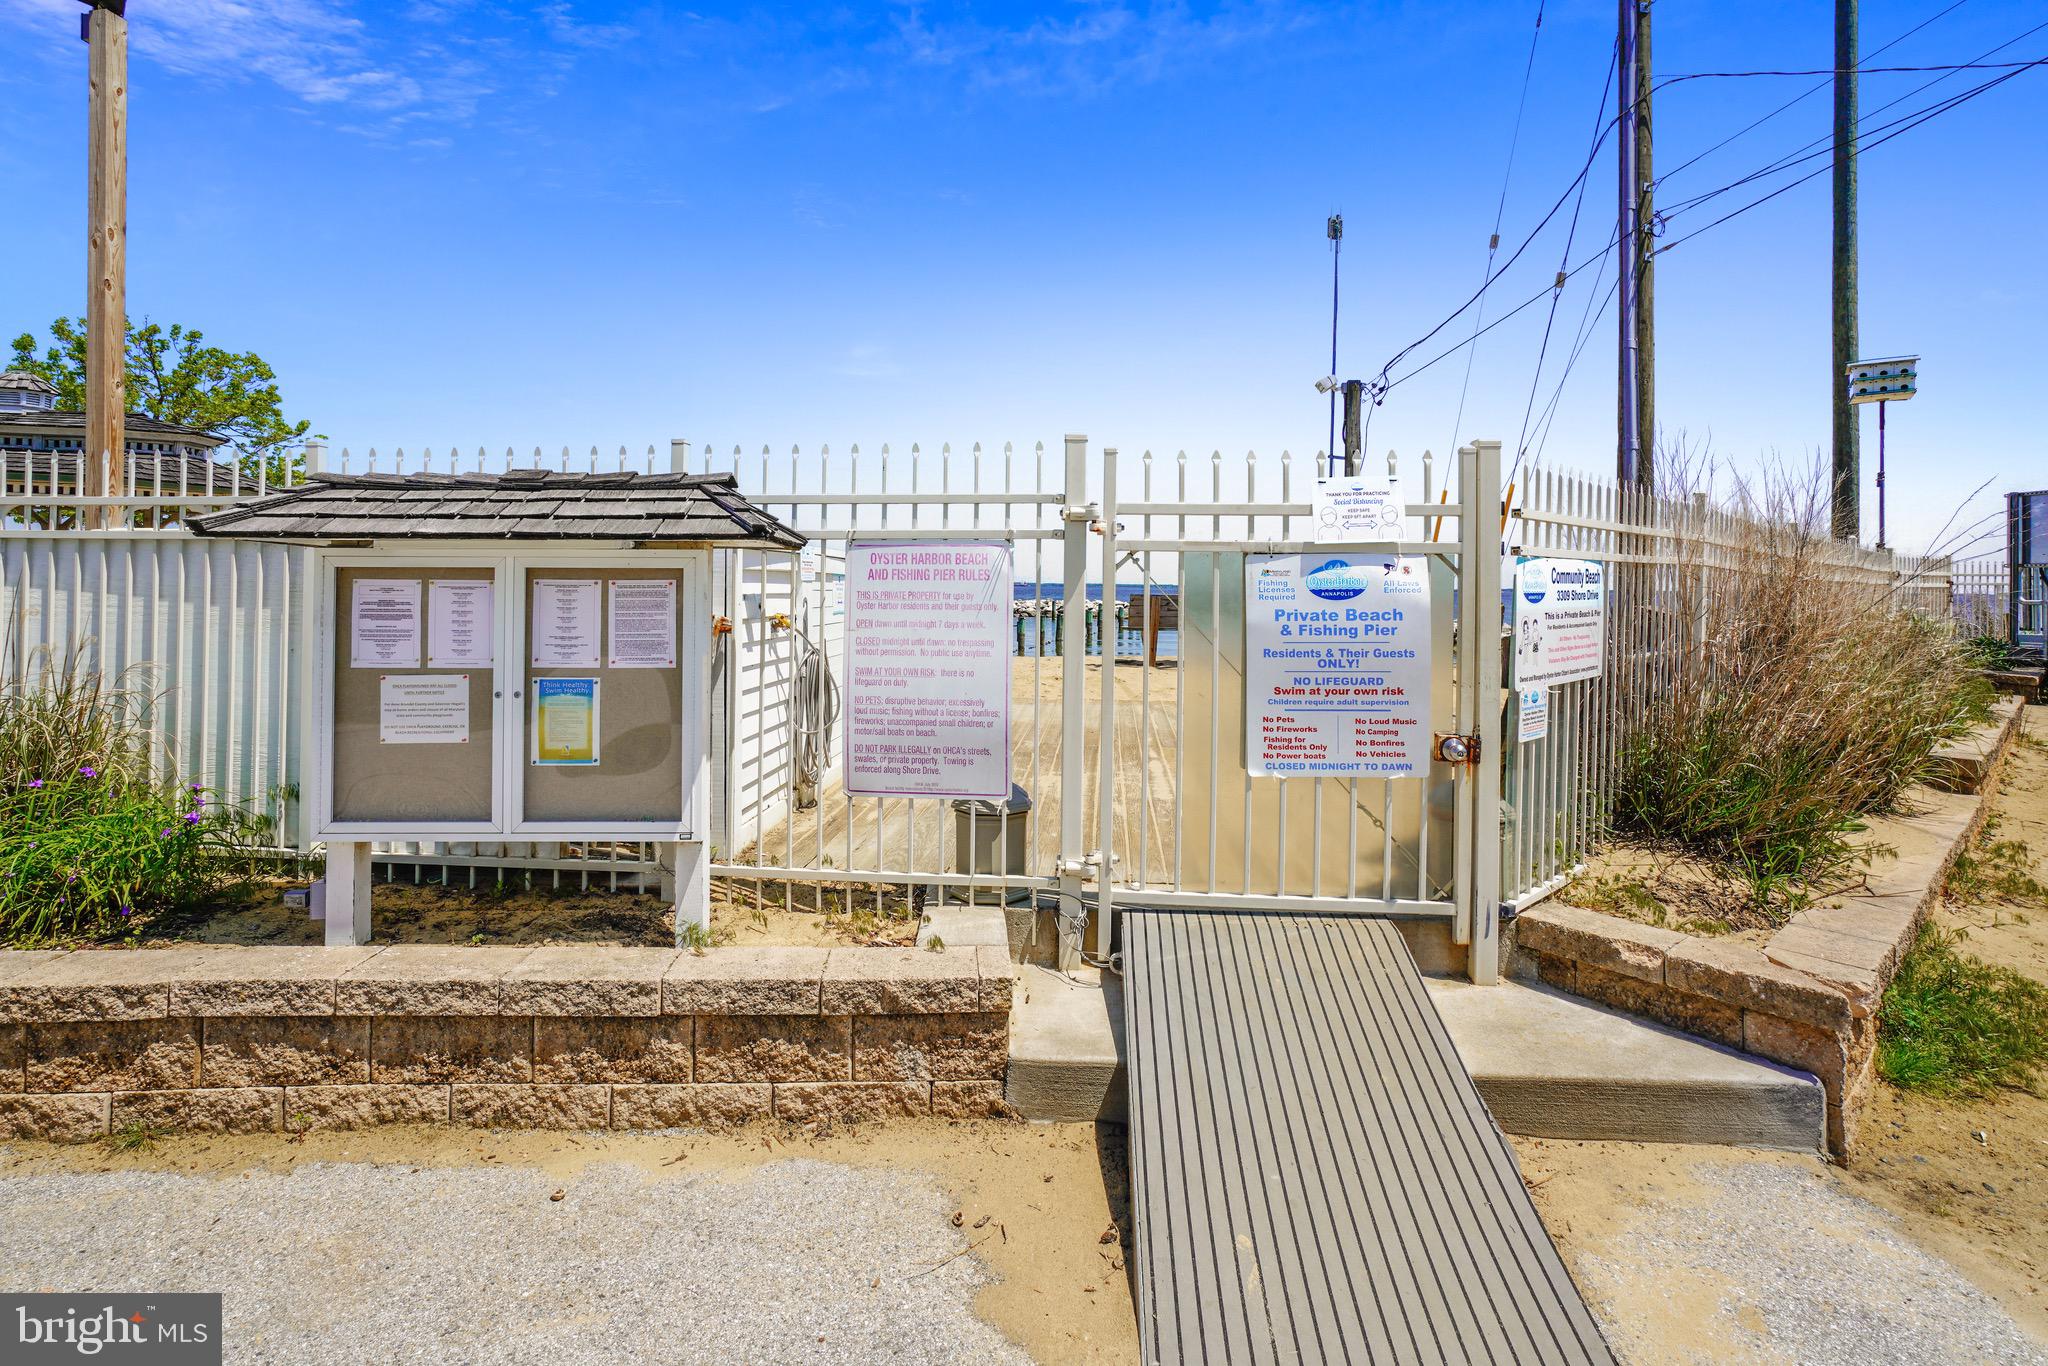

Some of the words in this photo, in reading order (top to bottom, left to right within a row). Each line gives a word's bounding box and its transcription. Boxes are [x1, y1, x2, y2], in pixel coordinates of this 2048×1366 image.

[870, 553, 908, 565] OYSTER
[911, 553, 951, 565] HARBOR
[955, 553, 988, 565] BEACH
[868, 569, 888, 581] AND
[892, 569, 930, 581] FISHING
[934, 569, 956, 580] PIER
[959, 569, 990, 581] RULES
[1552, 567, 1584, 588] Community
[1585, 568, 1600, 584] Beach
[857, 591, 870, 600] THIS
[873, 591, 878, 600] IS
[880, 591, 907, 600] PRIVATE
[908, 592, 941, 600] PROPERTY
[942, 592, 951, 600] for
[966, 592, 974, 601] by
[1557, 590, 1570, 601] 3309
[1571, 590, 1586, 600] Shore
[1587, 590, 1599, 600] Drive
[856, 602, 876, 611] Oyster
[945, 602, 959, 610] their
[961, 603, 982, 612] guests
[1274, 609, 1339, 622] Private
[1346, 609, 1403, 622] Beach
[856, 619, 873, 628] OPEN
[944, 621, 959, 630] days
[1280, 625, 1292, 636] &
[1299, 625, 1358, 638] Fishing
[1364, 625, 1398, 636] Pier
[855, 637, 880, 646] CLOSED
[882, 637, 909, 647] midnight
[911, 638, 925, 646] until
[957, 639, 994, 648] trespassing
[880, 648, 916, 657] permission.
[930, 649, 950, 658] public
[1263, 649, 1322, 658] Residents
[1326, 649, 1334, 658] &
[1338, 649, 1370, 658] Their
[1373, 649, 1415, 658] Guests
[1317, 659, 1360, 668] ONLY!
[855, 667, 872, 676] SWIM
[874, 668, 883, 676] AT
[884, 668, 900, 676] YOUR
[903, 668, 918, 676] OWN
[941, 668, 958, 677] there
[959, 669, 964, 677] is
[855, 678, 882, 687] lifeguard
[893, 678, 908, 688] duty.
[1293, 677, 1311, 685] NO
[1315, 677, 1384, 686] LIFEGUARD
[1274, 687, 1305, 695] Swim
[1324, 689, 1350, 697] your
[1381, 687, 1404, 695] risk
[855, 696, 863, 704] NO
[885, 696, 916, 706] disruptive
[948, 698, 984, 707] excessively
[892, 707, 913, 717] fishing
[915, 708, 938, 716] without
[887, 718, 937, 727] unaccompanied
[938, 719, 956, 727] small
[855, 744, 863, 752] DO
[865, 744, 877, 753] NOT
[880, 744, 896, 753] PARK
[899, 744, 931, 754] ILLEGALLY
[967, 748, 991, 757] streets,
[854, 755, 878, 763] swales,
[888, 756, 909, 765] private
[911, 756, 939, 765] property.
[943, 757, 966, 766] Towing
[883, 766, 900, 775] along
